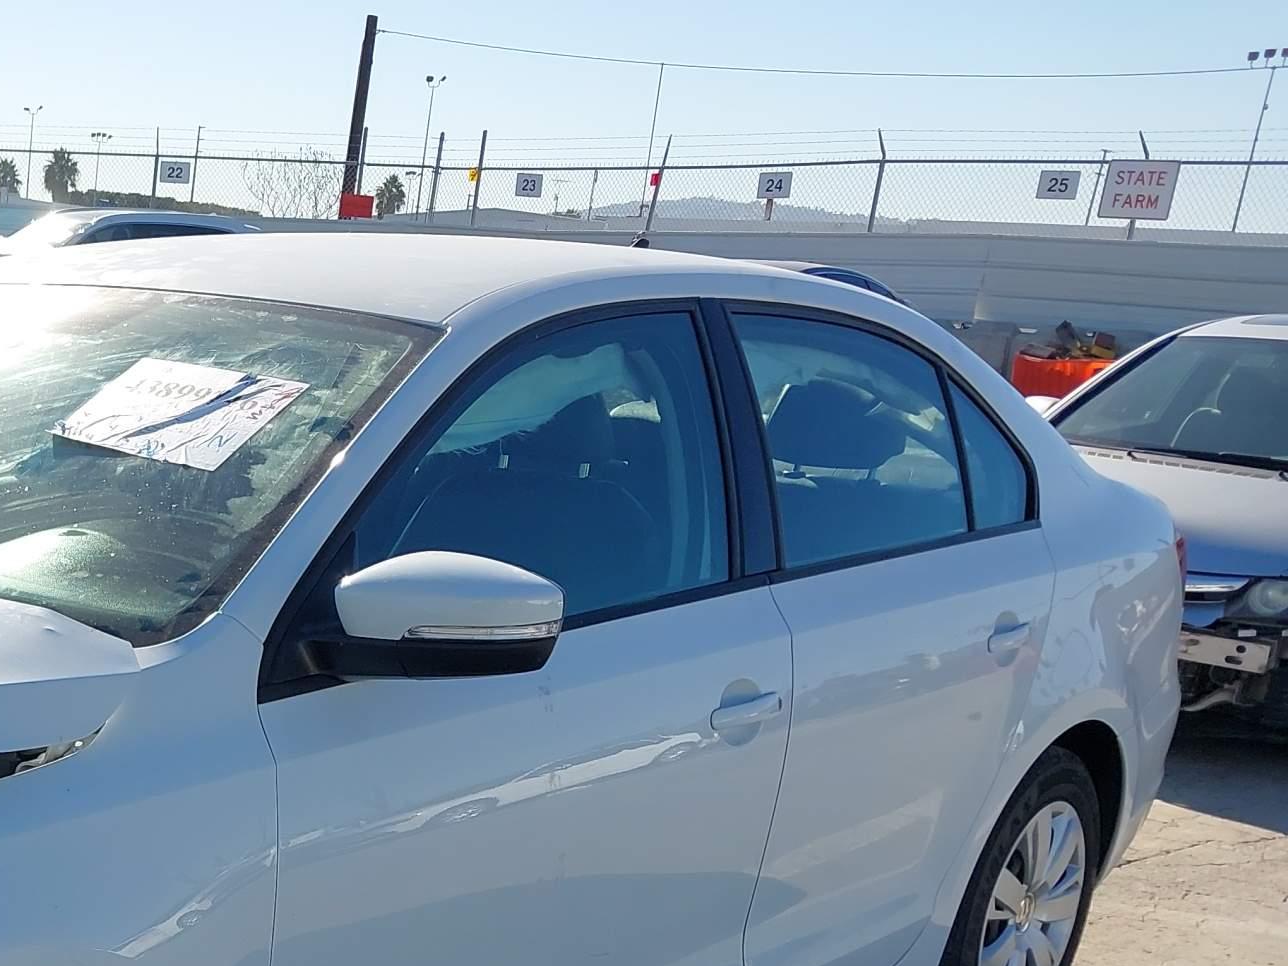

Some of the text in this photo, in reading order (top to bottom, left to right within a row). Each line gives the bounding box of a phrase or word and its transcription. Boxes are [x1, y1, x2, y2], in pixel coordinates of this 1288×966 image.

[167, 166, 183, 179] 22
[1114, 170, 1168, 186] STATE
[521, 178, 536, 192] 23
[765, 178, 783, 193] 24
[1047, 177, 1069, 193] 25
[1111, 193, 1160, 209] FARM
